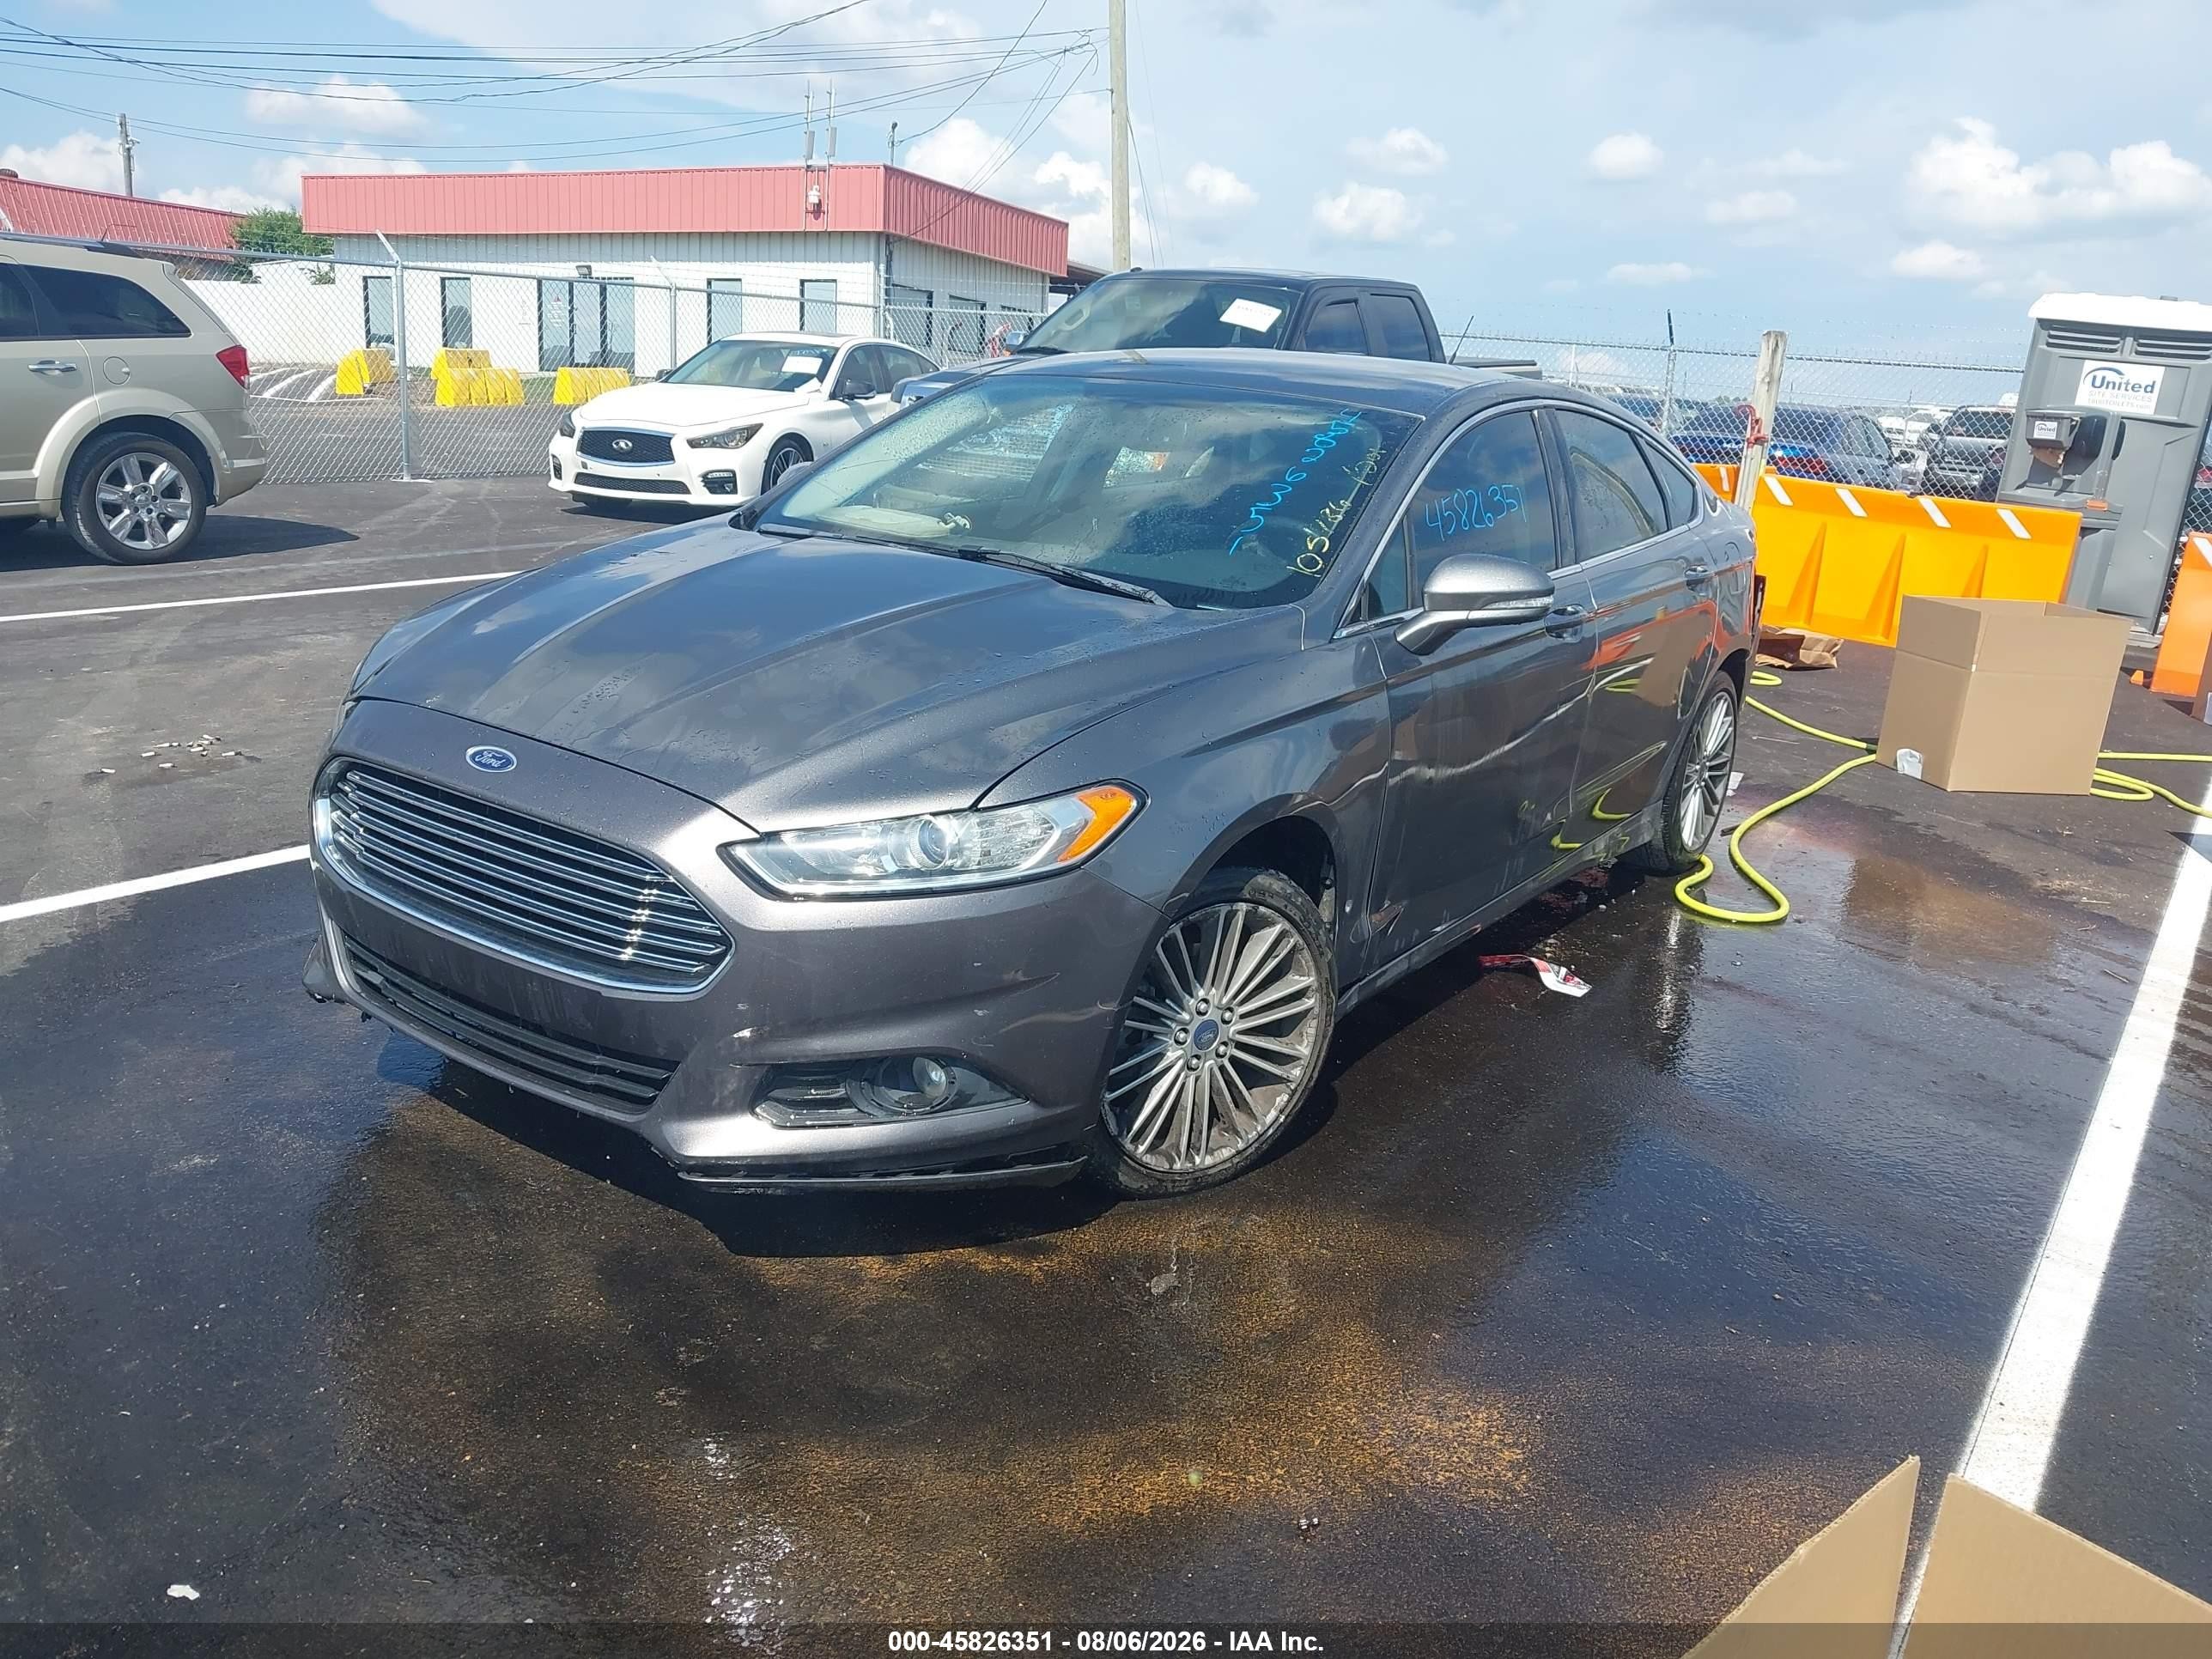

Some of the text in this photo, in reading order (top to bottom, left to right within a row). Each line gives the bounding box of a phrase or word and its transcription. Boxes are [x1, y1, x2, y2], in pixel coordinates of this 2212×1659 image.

[2091, 375, 2156, 393] United
[2110, 392, 2153, 403] SERVICES
[1425, 483, 1528, 542] 45826351
[475, 750, 507, 768] Ford
